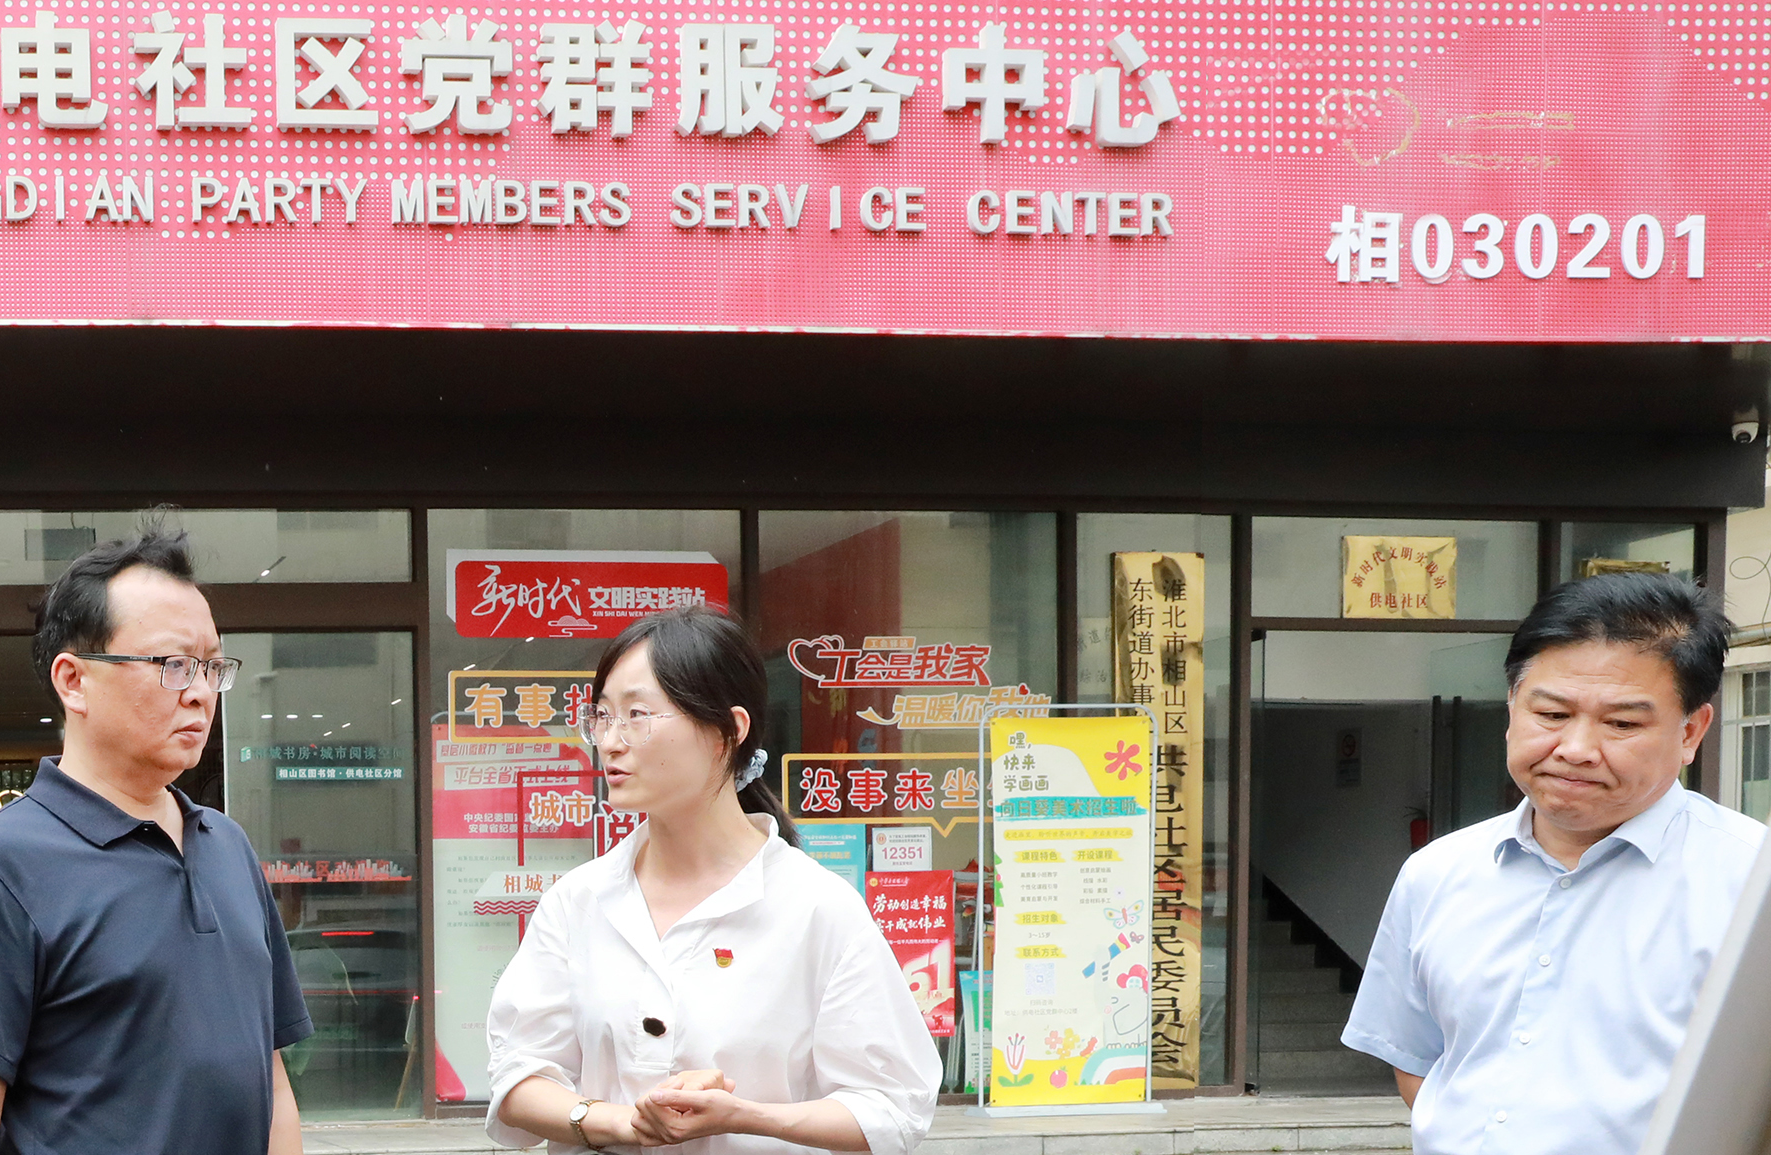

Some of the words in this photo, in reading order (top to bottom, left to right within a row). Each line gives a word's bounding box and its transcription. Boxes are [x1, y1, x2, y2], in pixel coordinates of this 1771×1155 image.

[192, 176, 367, 225] PARTY
[391, 179, 631, 228] MEMBERS
[670, 183, 927, 234] SERVICE
[966, 188, 1174, 239] CENTER
[1325, 205, 1707, 283] 相030201
[1350, 546, 1447, 590] 新时代文明实践站
[470, 564, 582, 637] 新时代
[588, 586, 706, 609] 文明实践站
[1370, 592, 1429, 610] 供电社区
[871, 639, 909, 648] 工会驿站
[1129, 577, 1155, 733] 东街道办事
[1162, 578, 1188, 735] 淮北市相山区
[817, 644, 993, 688] 工会是我家
[1003, 753, 1035, 771] 快来
[800, 767, 994, 812] 没事来坐
[1003, 775, 1050, 792] 学画画
[529, 790, 596, 827] 城市
[1000, 798, 1137, 817] 向日葵美术招生啦
[882, 846, 924, 860] 12351
[1021, 851, 1058, 861] 课程特色
[1077, 850, 1113, 860] 开设课程
[872, 893, 948, 915] 劳动创造幸福
[1022, 914, 1058, 924] 招生对象
[1022, 948, 1060, 958] 联系方式
